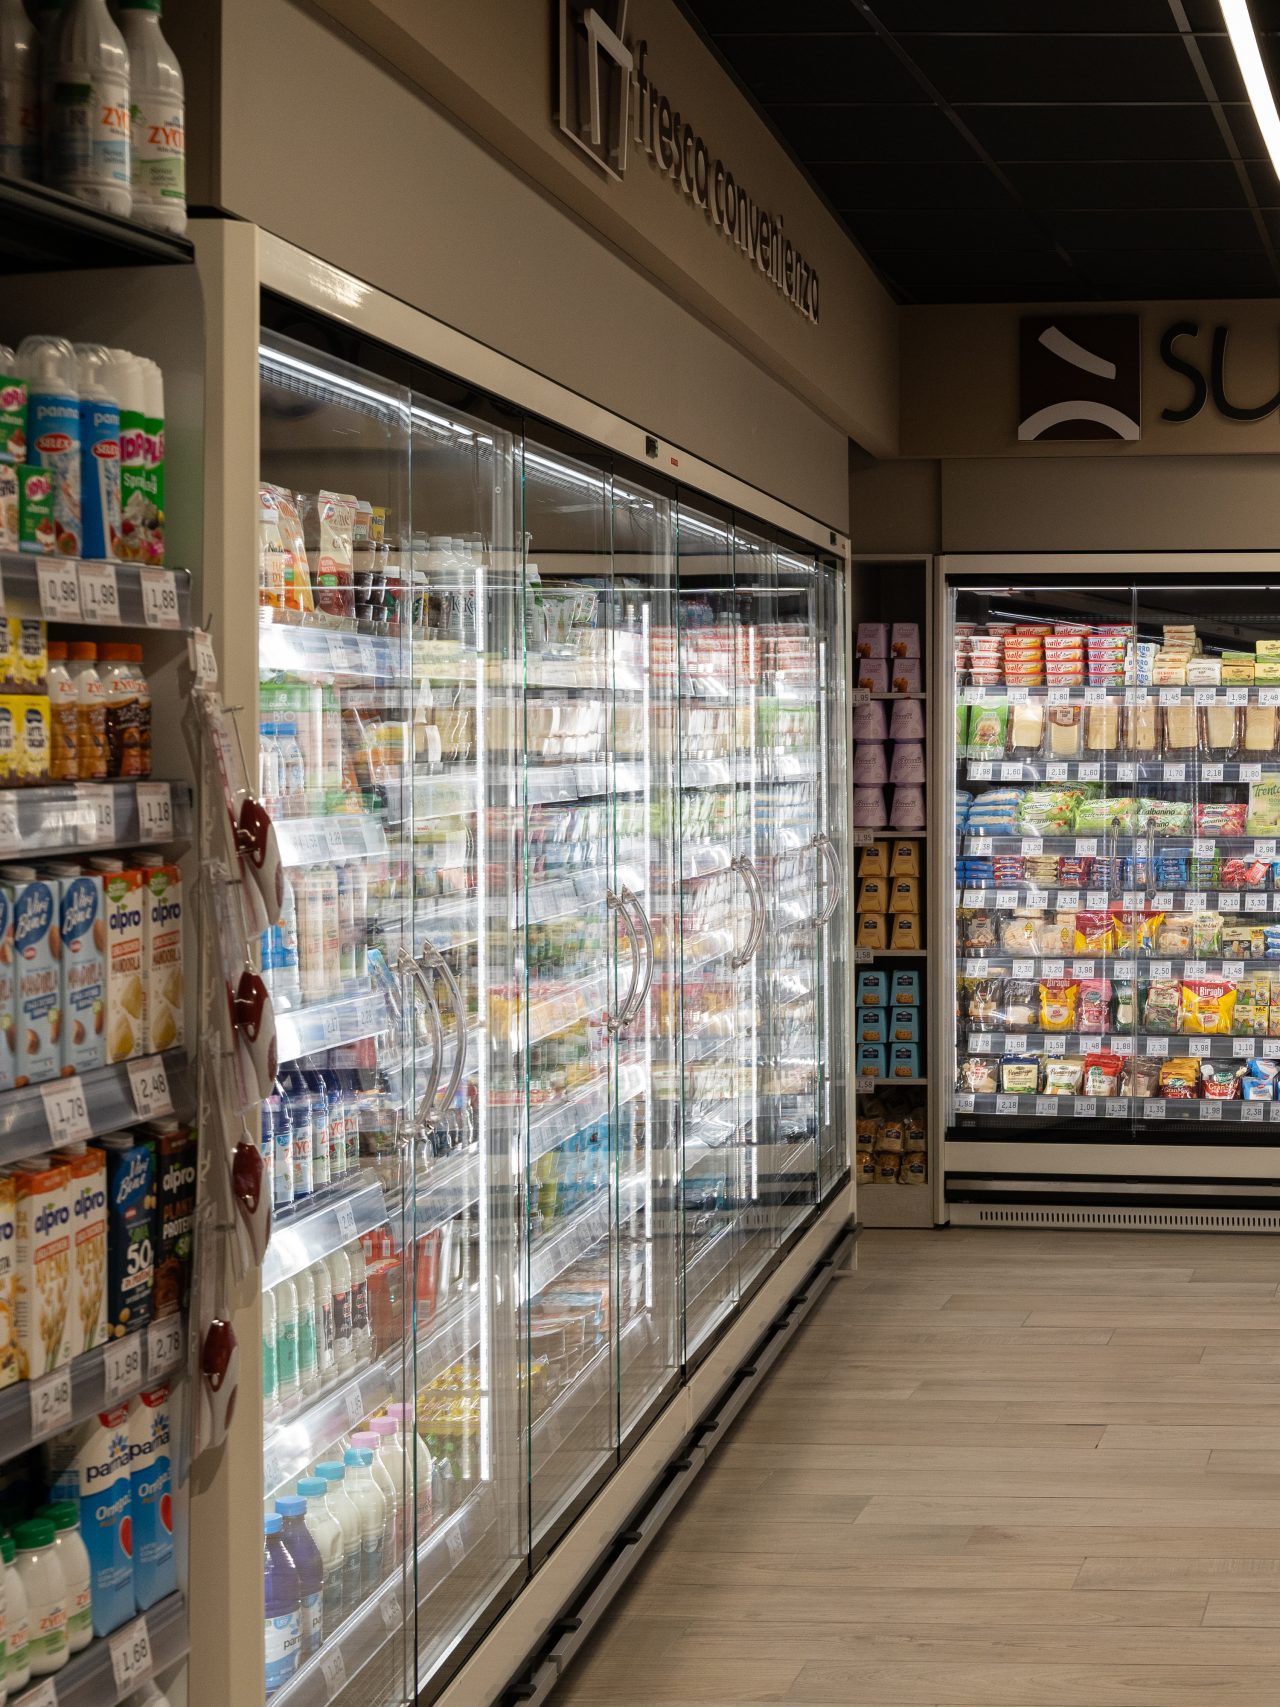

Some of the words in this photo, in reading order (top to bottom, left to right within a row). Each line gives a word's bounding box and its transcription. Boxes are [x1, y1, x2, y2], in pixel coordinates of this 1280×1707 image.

[710, 159, 819, 325] convenienza
[90, 584, 116, 606] 1,98
[152, 588, 175, 609] 1,88
[1053, 693, 1068, 701] 1,80
[1090, 693, 1104, 701] 1,80
[1164, 694, 1179, 702] 1,45
[1199, 694, 1214, 702] 2,98
[1232, 694, 1246, 702] 1,98
[1264, 694, 1278, 702] 2,48
[146, 802, 170, 822] 1,18
[1198, 845, 1213, 853] 2,98
[1032, 896, 1046, 904] 1,78
[152, 903, 181, 927] alpro
[110, 910, 141, 934] alpro
[856, 952, 870, 960] 1,58
[1078, 966, 1092, 974] 3,98
[1154, 968, 1169, 976] 2,50
[1200, 986, 1224, 997] Biraghi
[1194, 1044, 1208, 1052] 3,98
[140, 1074, 166, 1098] 2,48
[858, 1080, 872, 1088] 1,58
[56, 1097, 84, 1123] 1,78
[1002, 1102, 1016, 1110] 2,18
[1080, 1104, 1094, 1112] 1,00
[1246, 1108, 1262, 1117] 2,38
[163, 1167, 195, 1193] alpro
[74, 1190, 104, 1220] alpro
[35, 1206, 69, 1236] alpro
[156, 1331, 180, 1359] 2,78
[114, 1351, 138, 1381] 1,98
[42, 1382, 68, 1414] 2,48
[122, 1638, 148, 1672] 1,68
